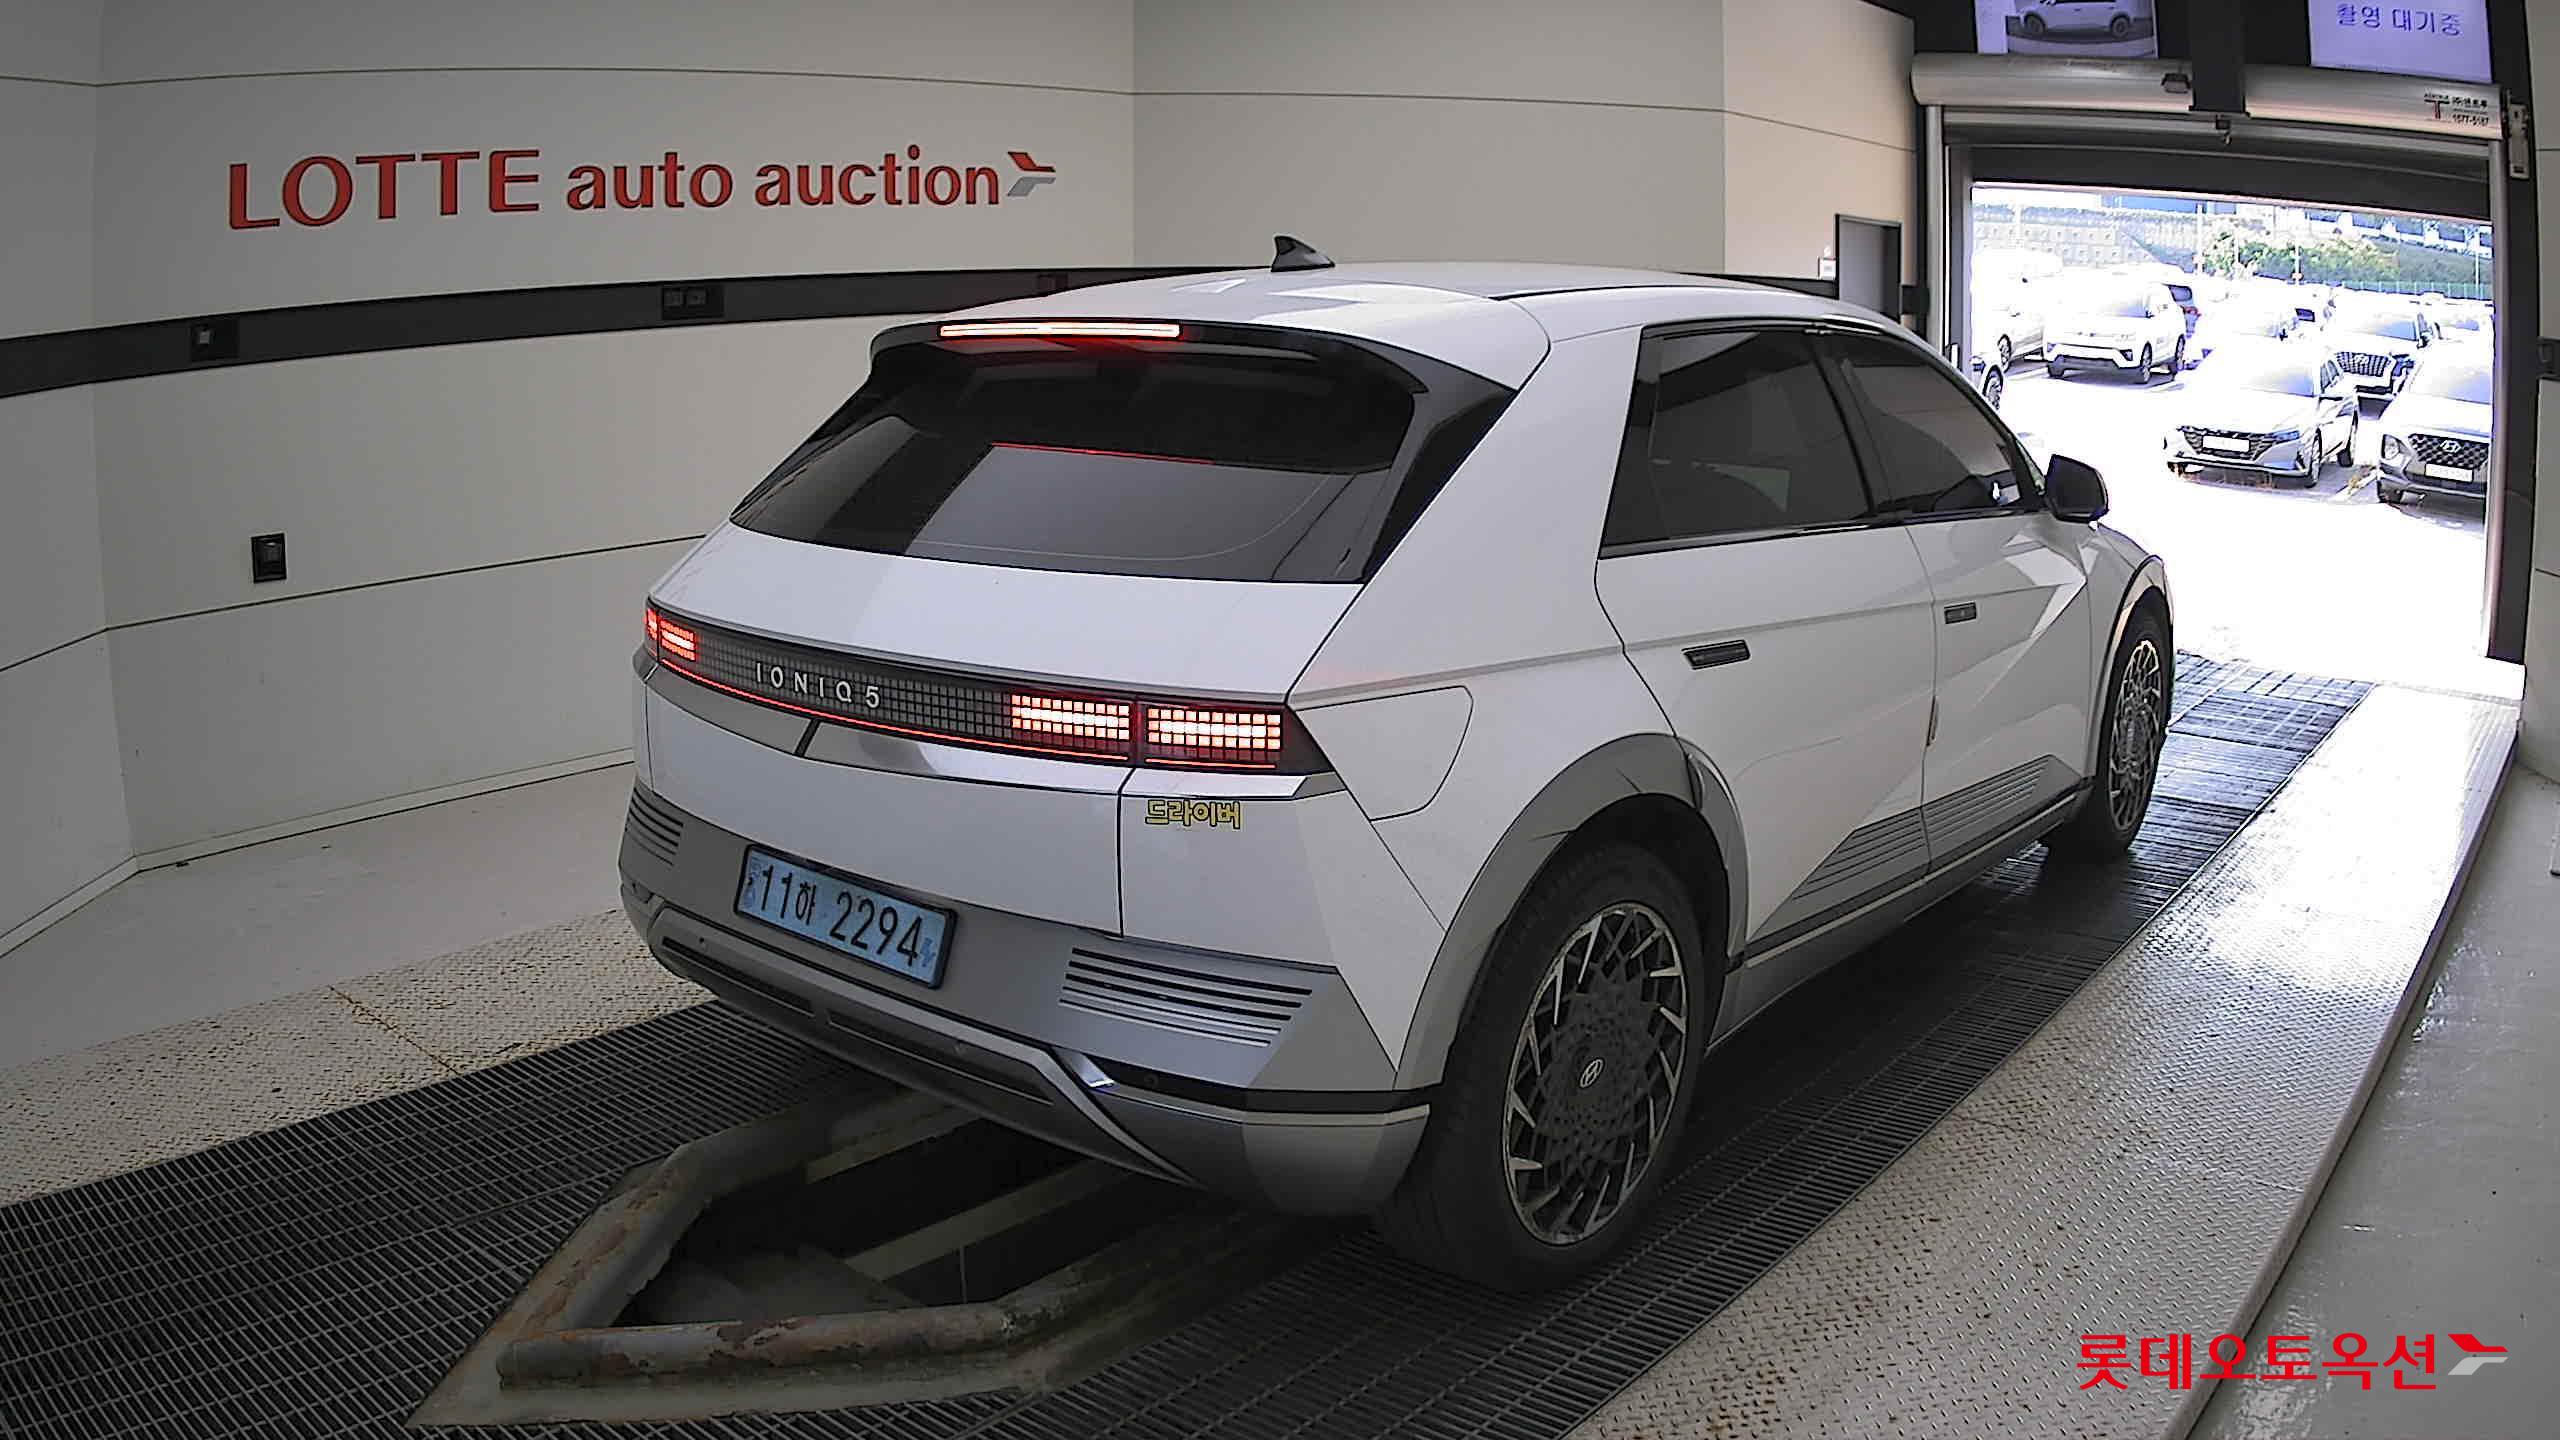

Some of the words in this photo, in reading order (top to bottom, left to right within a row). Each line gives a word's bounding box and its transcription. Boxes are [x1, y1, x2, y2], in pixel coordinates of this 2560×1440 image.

[2338, 4, 2380, 28] 촬영
[2392, 8, 2460, 36] 대기중
[229, 149, 540, 230] LOTTE
[566, 151, 733, 209] auto
[754, 144, 1000, 206] auction
[756, 662, 852, 703] IONIQ
[865, 685, 880, 709] 5
[1144, 799, 1241, 830] 드라이버
[761, 865, 816, 926] 11하
[829, 891, 923, 967] 2294
